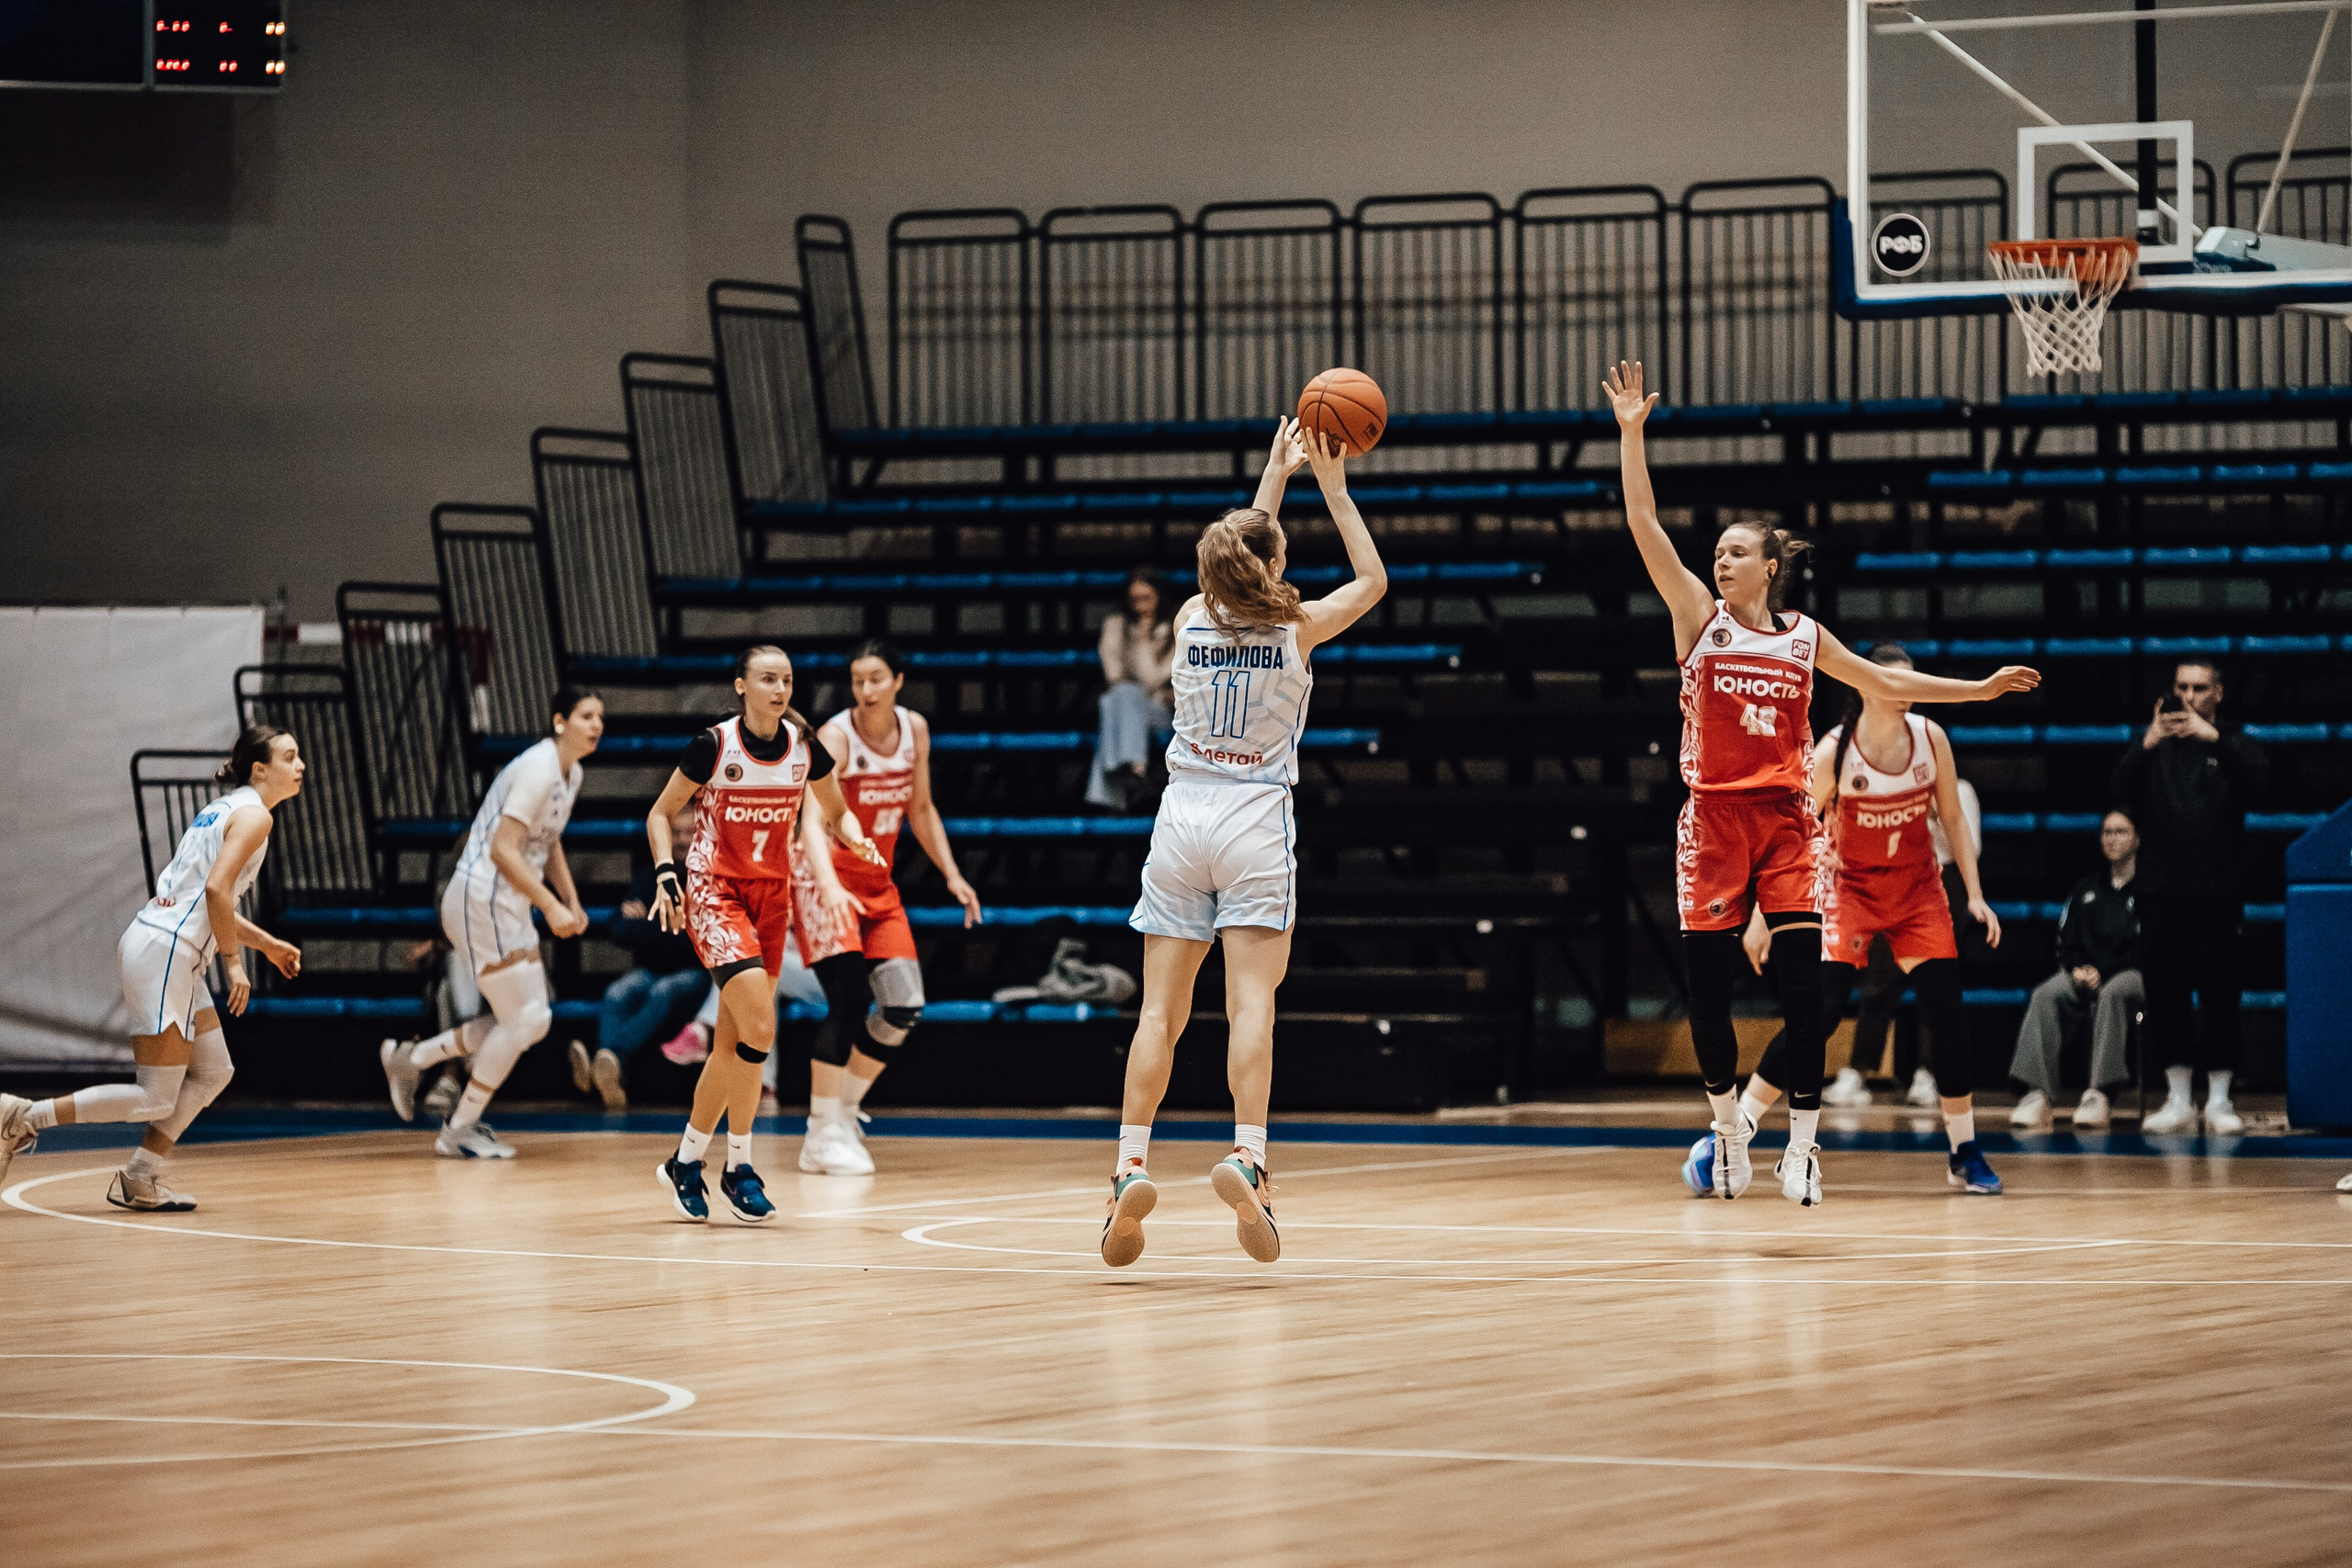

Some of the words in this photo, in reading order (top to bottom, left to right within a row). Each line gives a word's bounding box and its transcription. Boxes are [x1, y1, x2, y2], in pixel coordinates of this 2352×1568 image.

[1187, 644, 1283, 670] ФЕФИЛОВА
[1713, 675, 1801, 699] ЮНОСТЬ
[1211, 670, 1250, 739] 11
[725, 806, 792, 823] ЮНОСТ
[752, 829, 770, 863] 7
